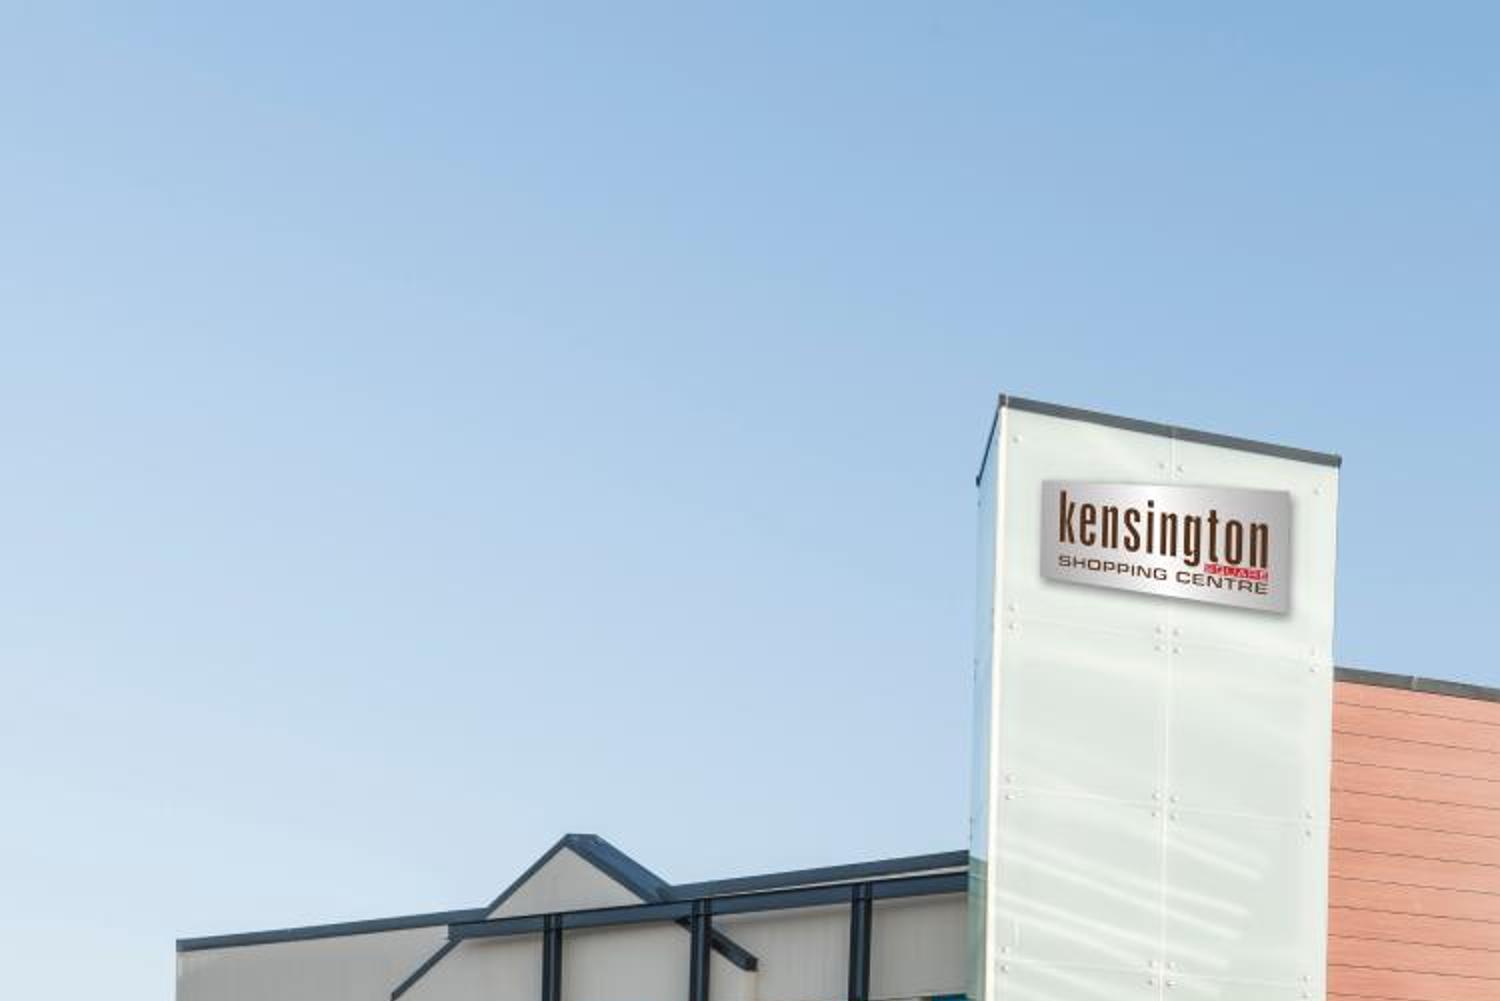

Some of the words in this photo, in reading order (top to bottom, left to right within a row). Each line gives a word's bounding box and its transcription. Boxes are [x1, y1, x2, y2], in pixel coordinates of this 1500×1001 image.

[1059, 490, 1269, 568] kensington
[1058, 554, 1168, 581] SHOPPING
[1175, 570, 1270, 595] CENTRE
